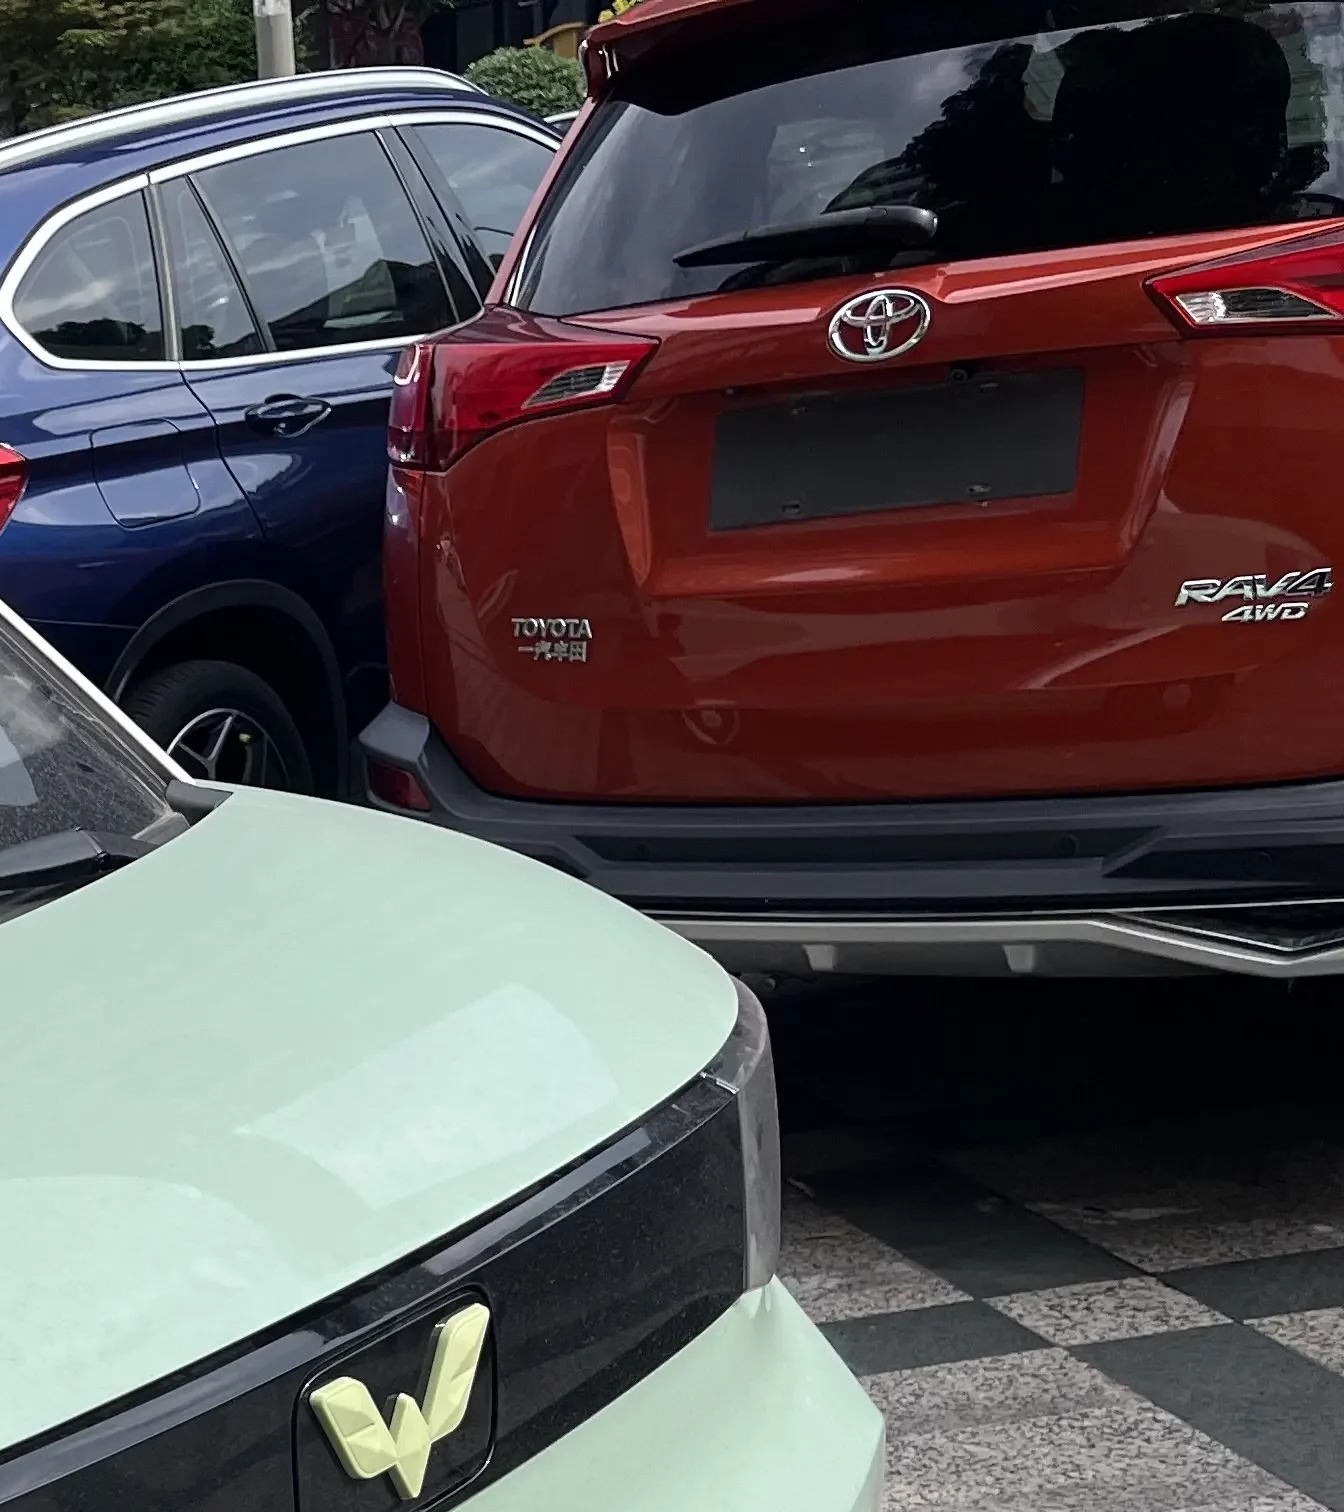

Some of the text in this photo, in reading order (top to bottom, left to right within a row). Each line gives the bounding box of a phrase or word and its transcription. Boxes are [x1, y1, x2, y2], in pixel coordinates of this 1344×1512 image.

[1174, 567, 1335, 607] RAV4
[1221, 602, 1310, 623] 4WD
[511, 617, 593, 639] TOYOTA
[517, 640, 588, 663] 一汽丰田
